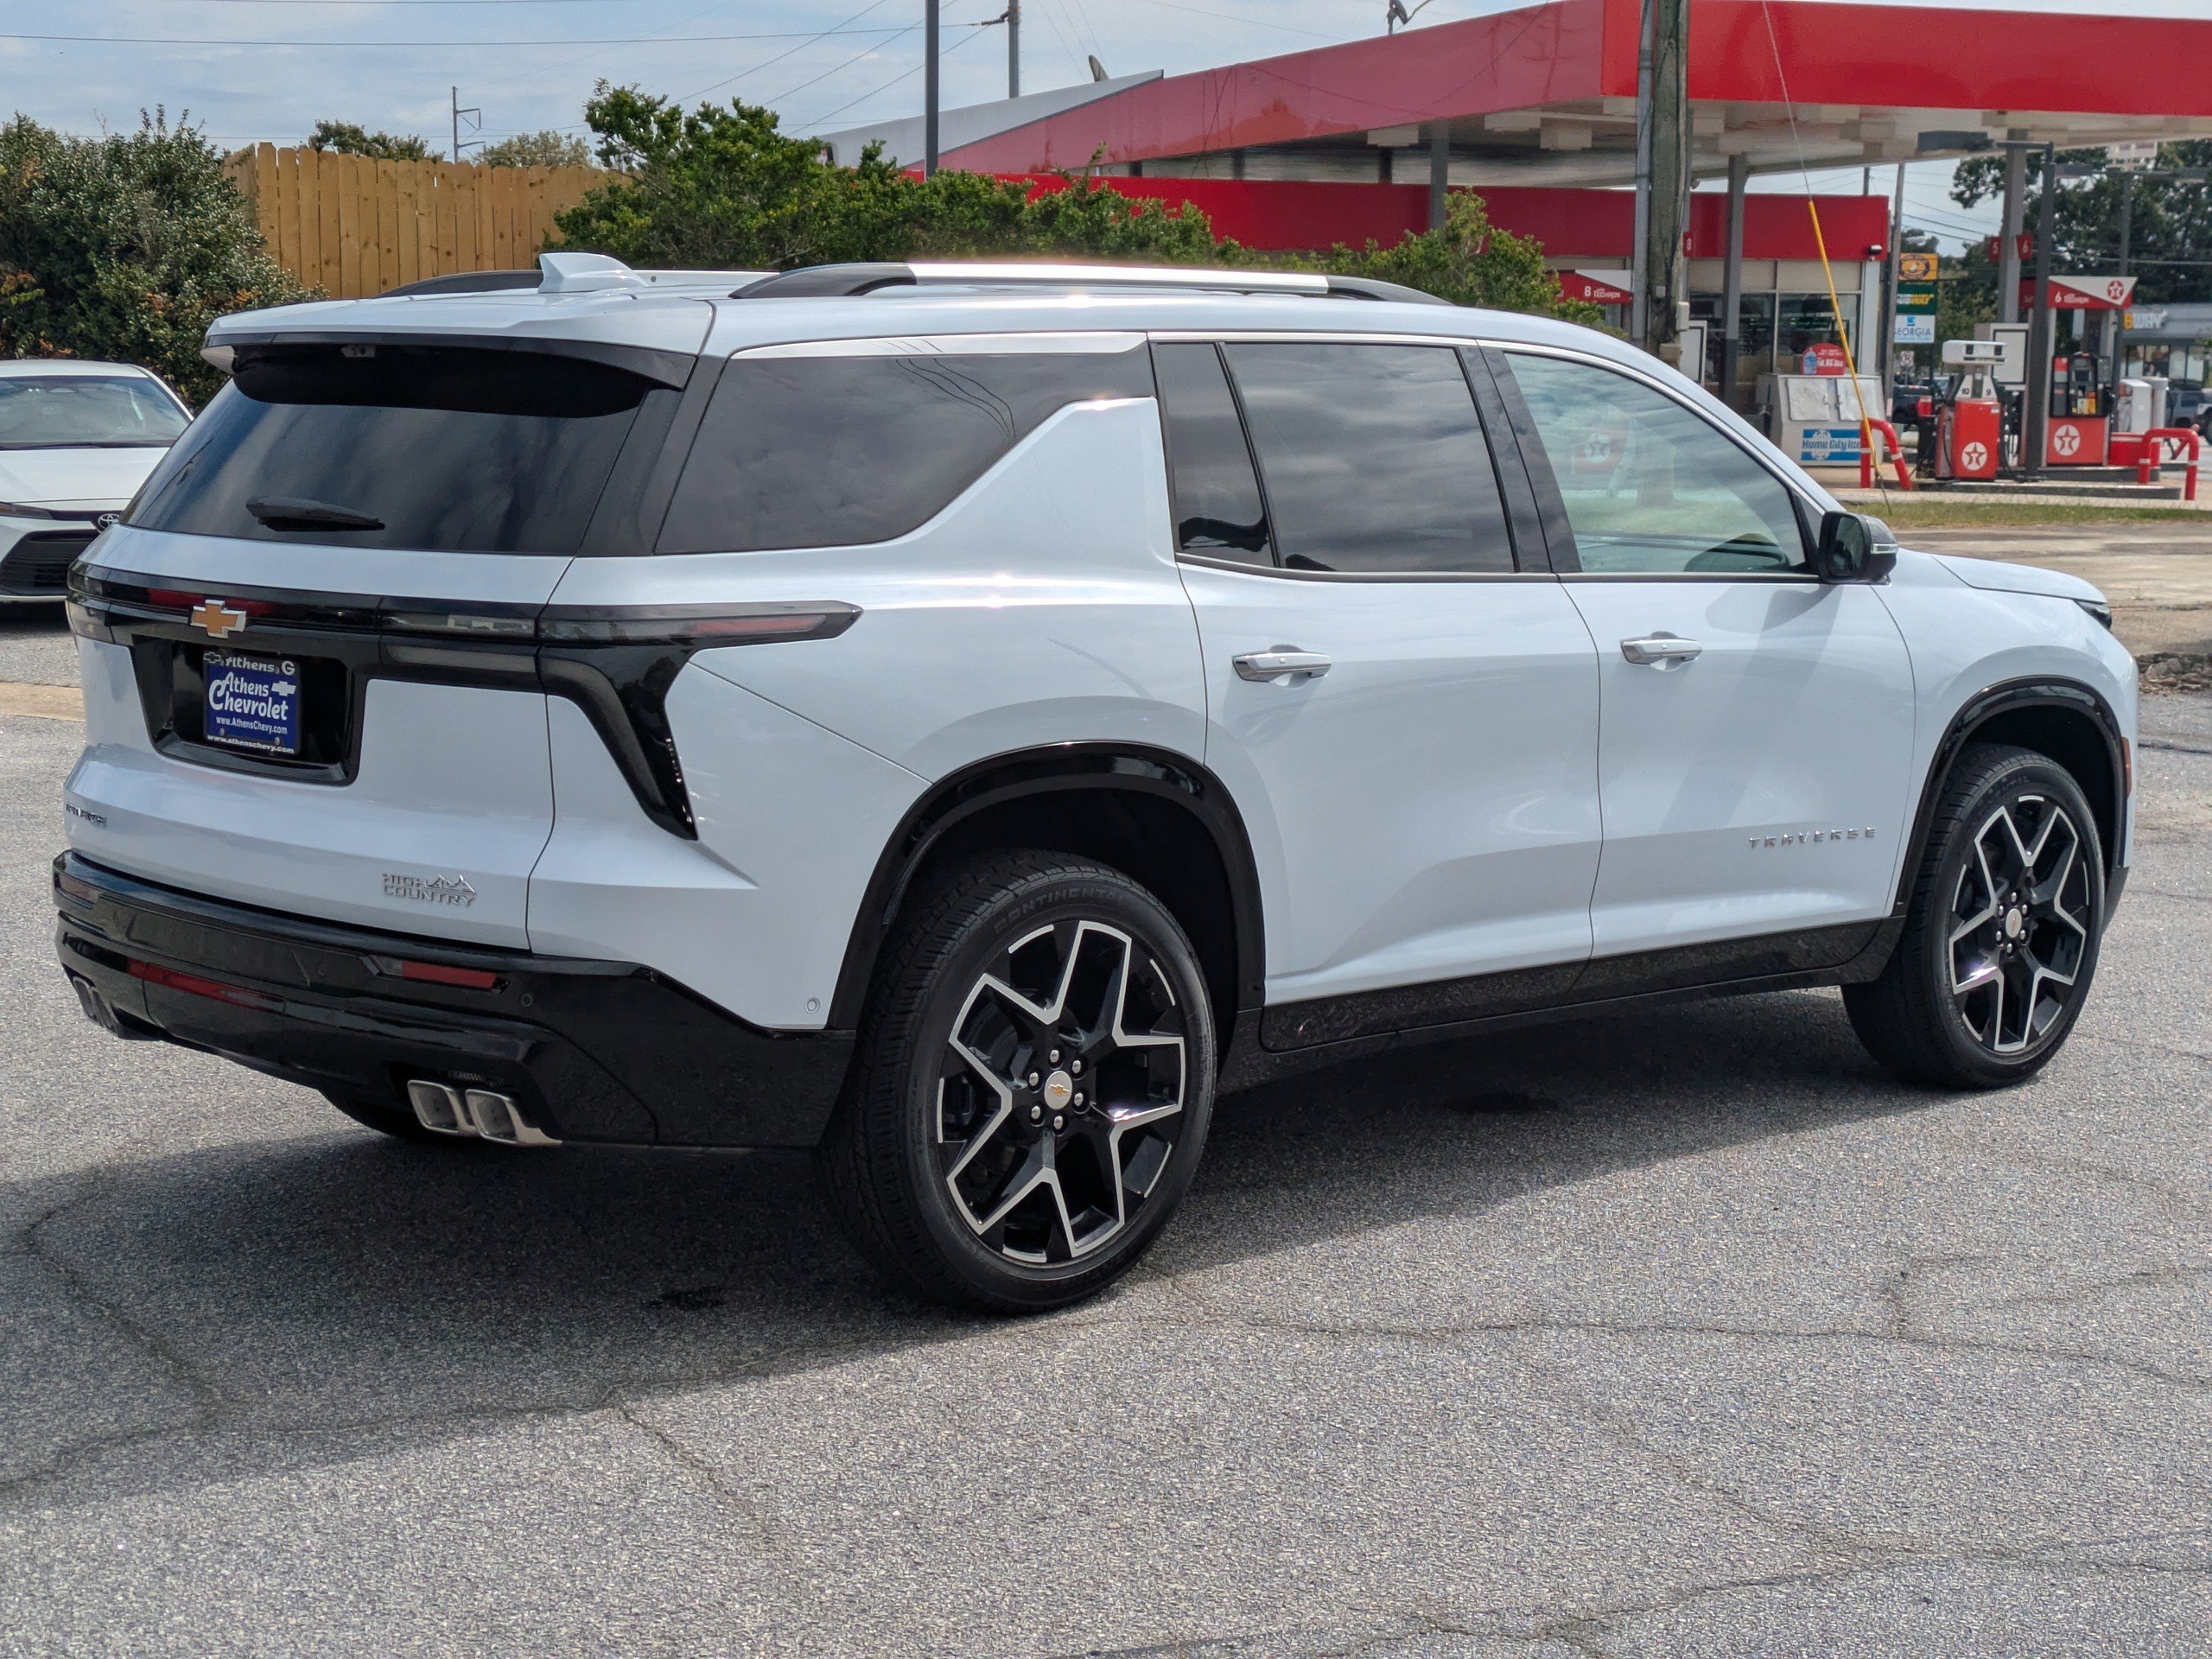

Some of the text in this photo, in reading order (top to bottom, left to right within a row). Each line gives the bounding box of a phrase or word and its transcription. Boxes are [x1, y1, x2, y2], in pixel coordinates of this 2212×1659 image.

[1993, 242, 1999, 254] 5
[2023, 240, 2029, 253] 6
[1584, 286, 1592, 297] 8
[2054, 291, 2062, 303] 6
[1895, 327, 1932, 336] EORGIA
[1802, 439, 1828, 449] Home
[1829, 439, 1847, 451] City
[225, 656, 296, 676] Athens G
[221, 671, 270, 697] Athens
[208, 679, 289, 721] Chevrolet
[216, 716, 288, 734] www.AthensChevy.com
[207, 734, 295, 754] www.athenschevy.com
[1749, 825, 1878, 849] TRAVERSE
[382, 885, 477, 906] COUNTRY
